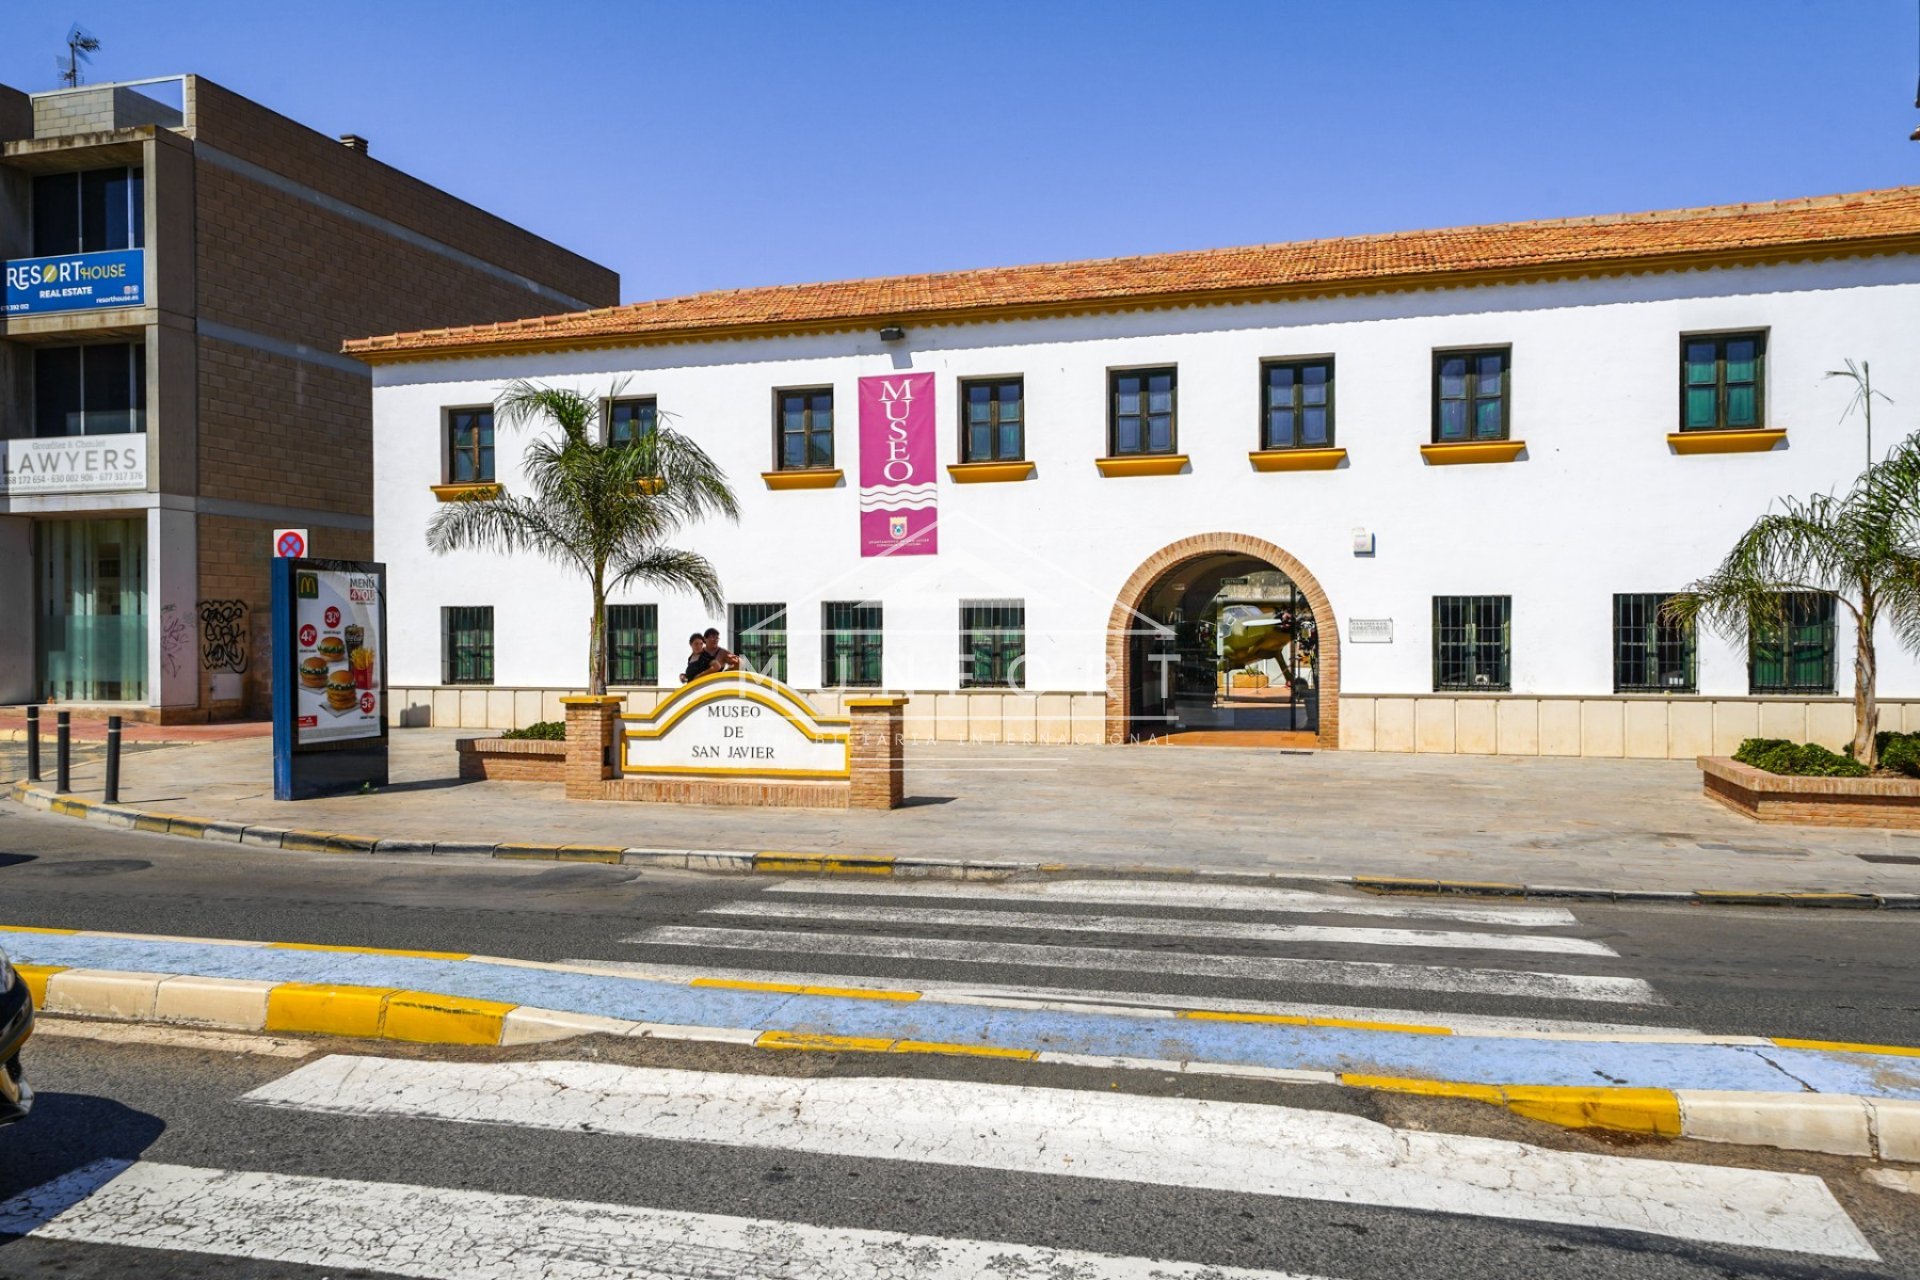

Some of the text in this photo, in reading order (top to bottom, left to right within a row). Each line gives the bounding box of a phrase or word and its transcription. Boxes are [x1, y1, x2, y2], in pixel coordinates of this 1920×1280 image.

[39, 286, 93, 299] REAL ESTATE
[878, 379, 915, 482] MUSEO
[2, 448, 137, 474] LAWYERS
[351, 590, 375, 600] 4YOU
[708, 705, 761, 718] MUSEO
[723, 726, 744, 738] DE
[691, 745, 775, 759] SAN JAVIER
